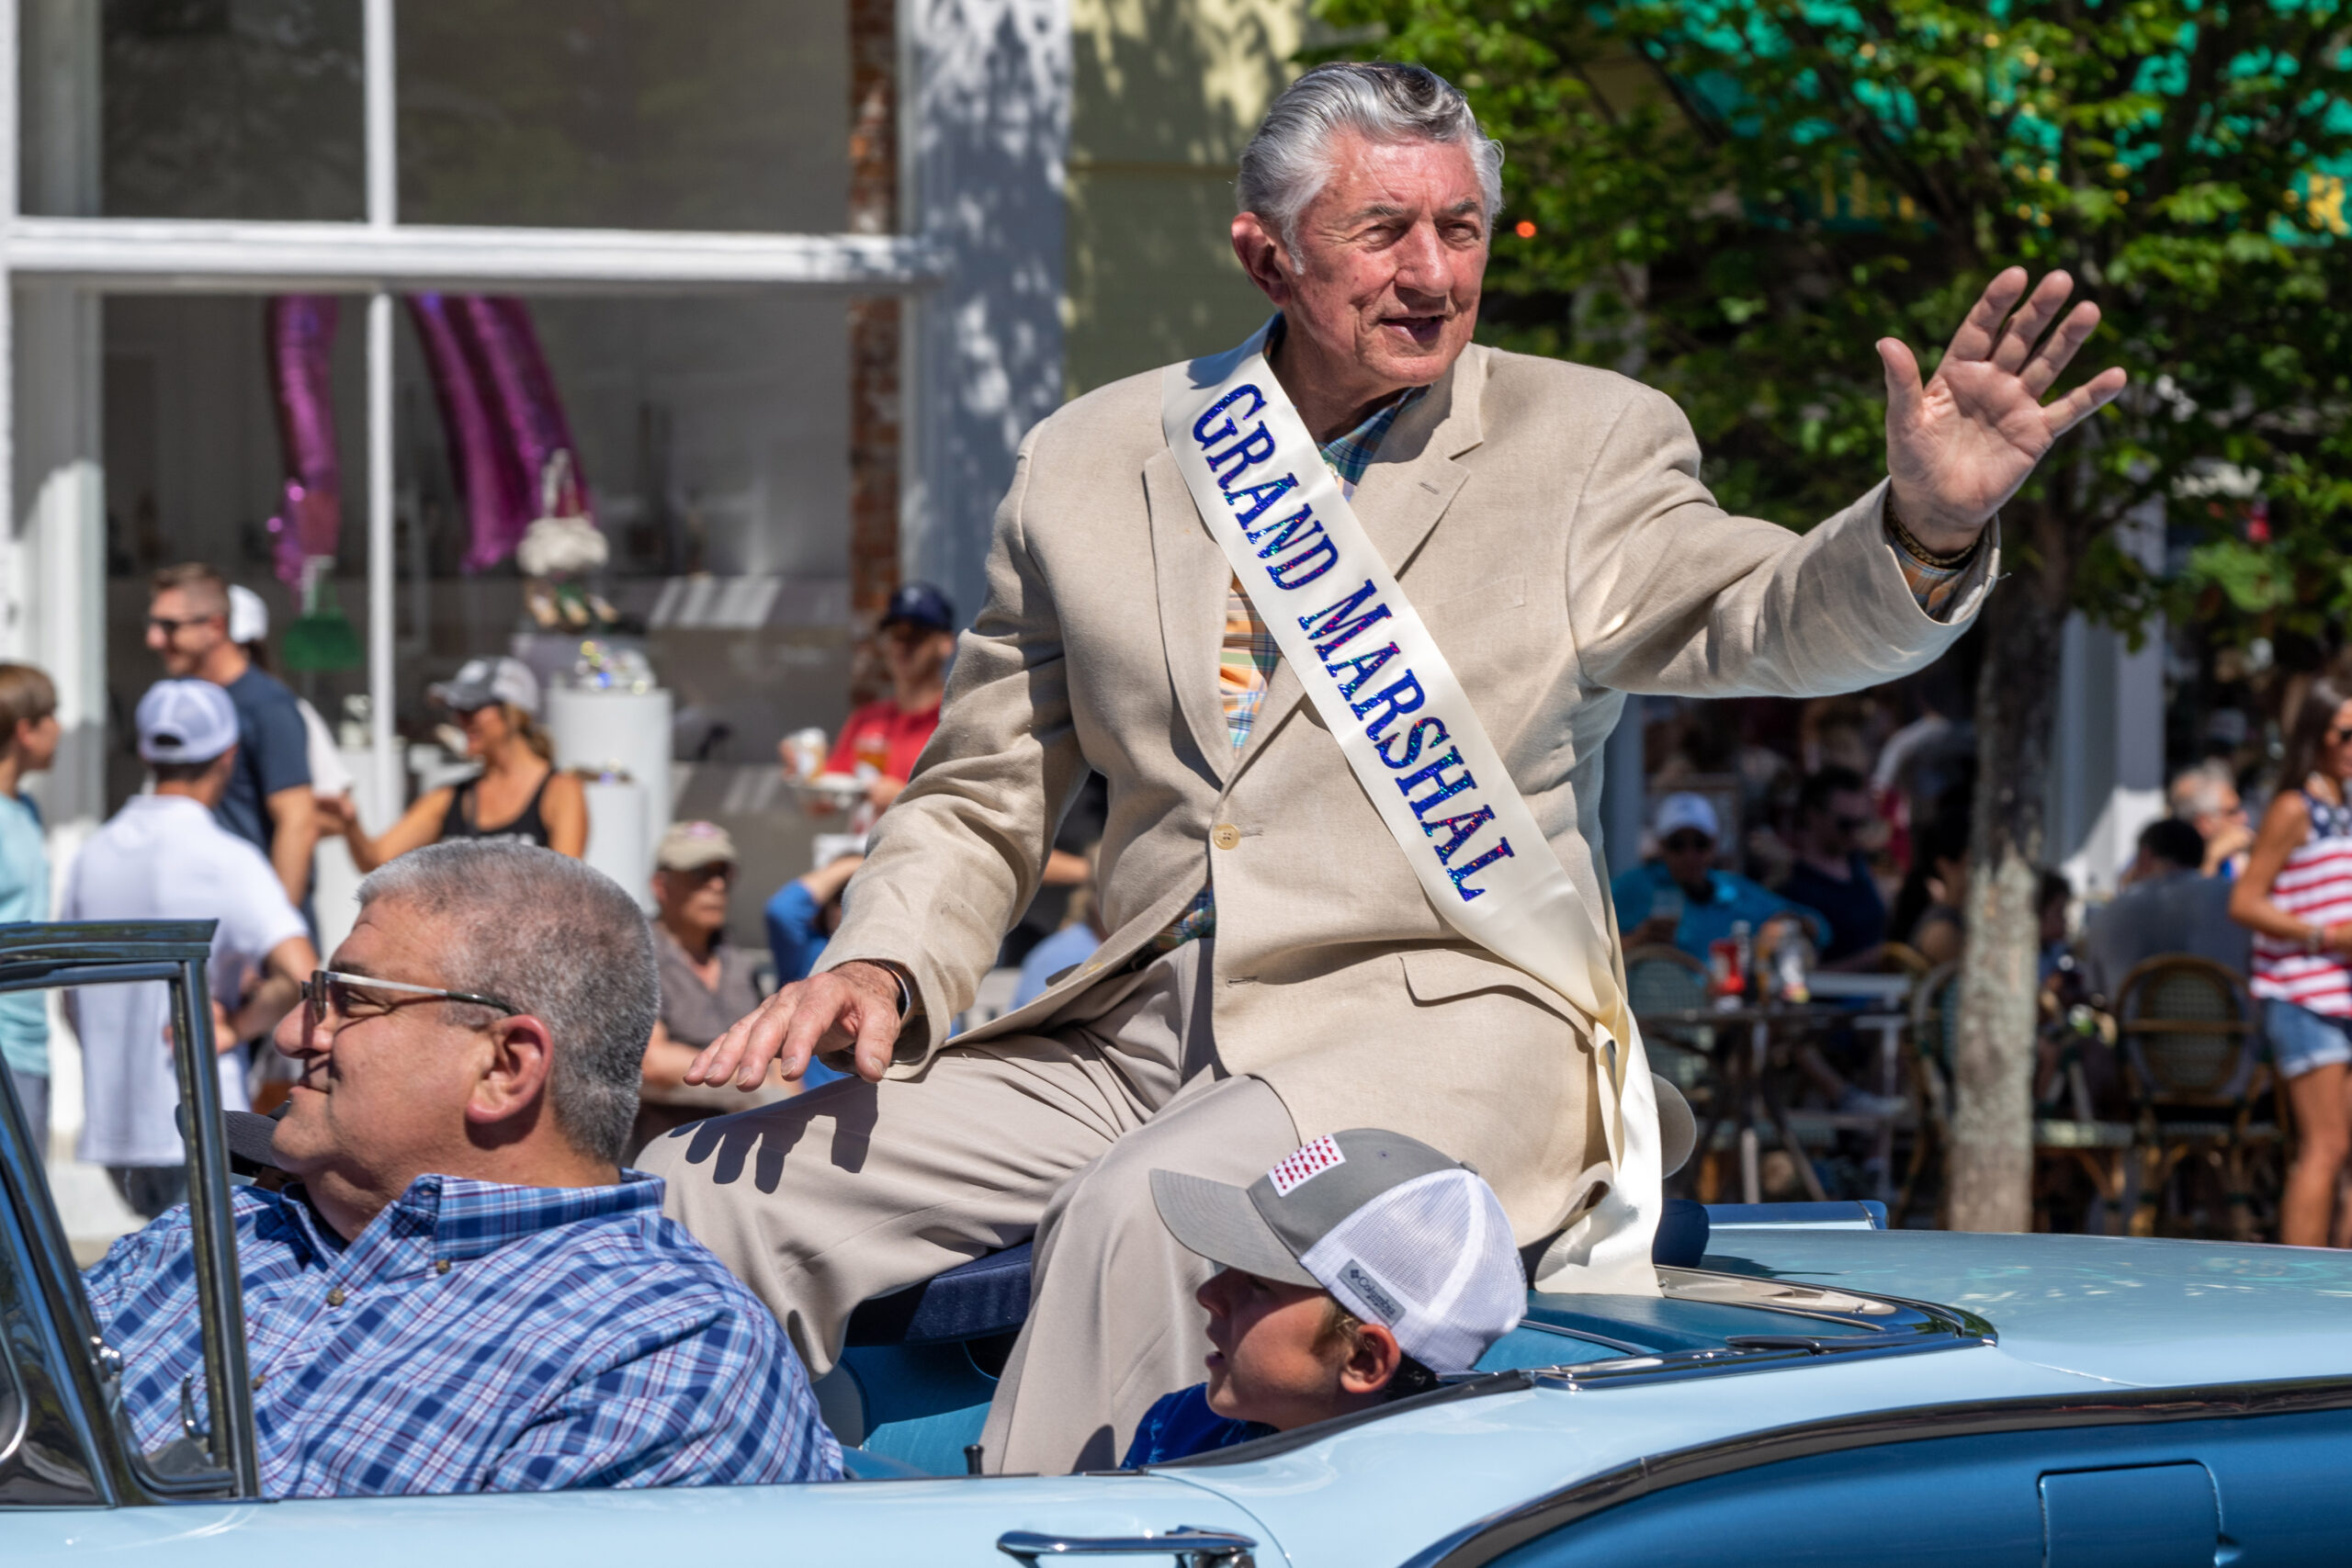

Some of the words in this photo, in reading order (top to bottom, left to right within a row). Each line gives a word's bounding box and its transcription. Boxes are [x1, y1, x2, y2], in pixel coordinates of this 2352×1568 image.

[1193, 383, 1339, 591] GRAND
[1298, 580, 1516, 903] MARSHAL
[1358, 1276, 1396, 1315] Columbia
